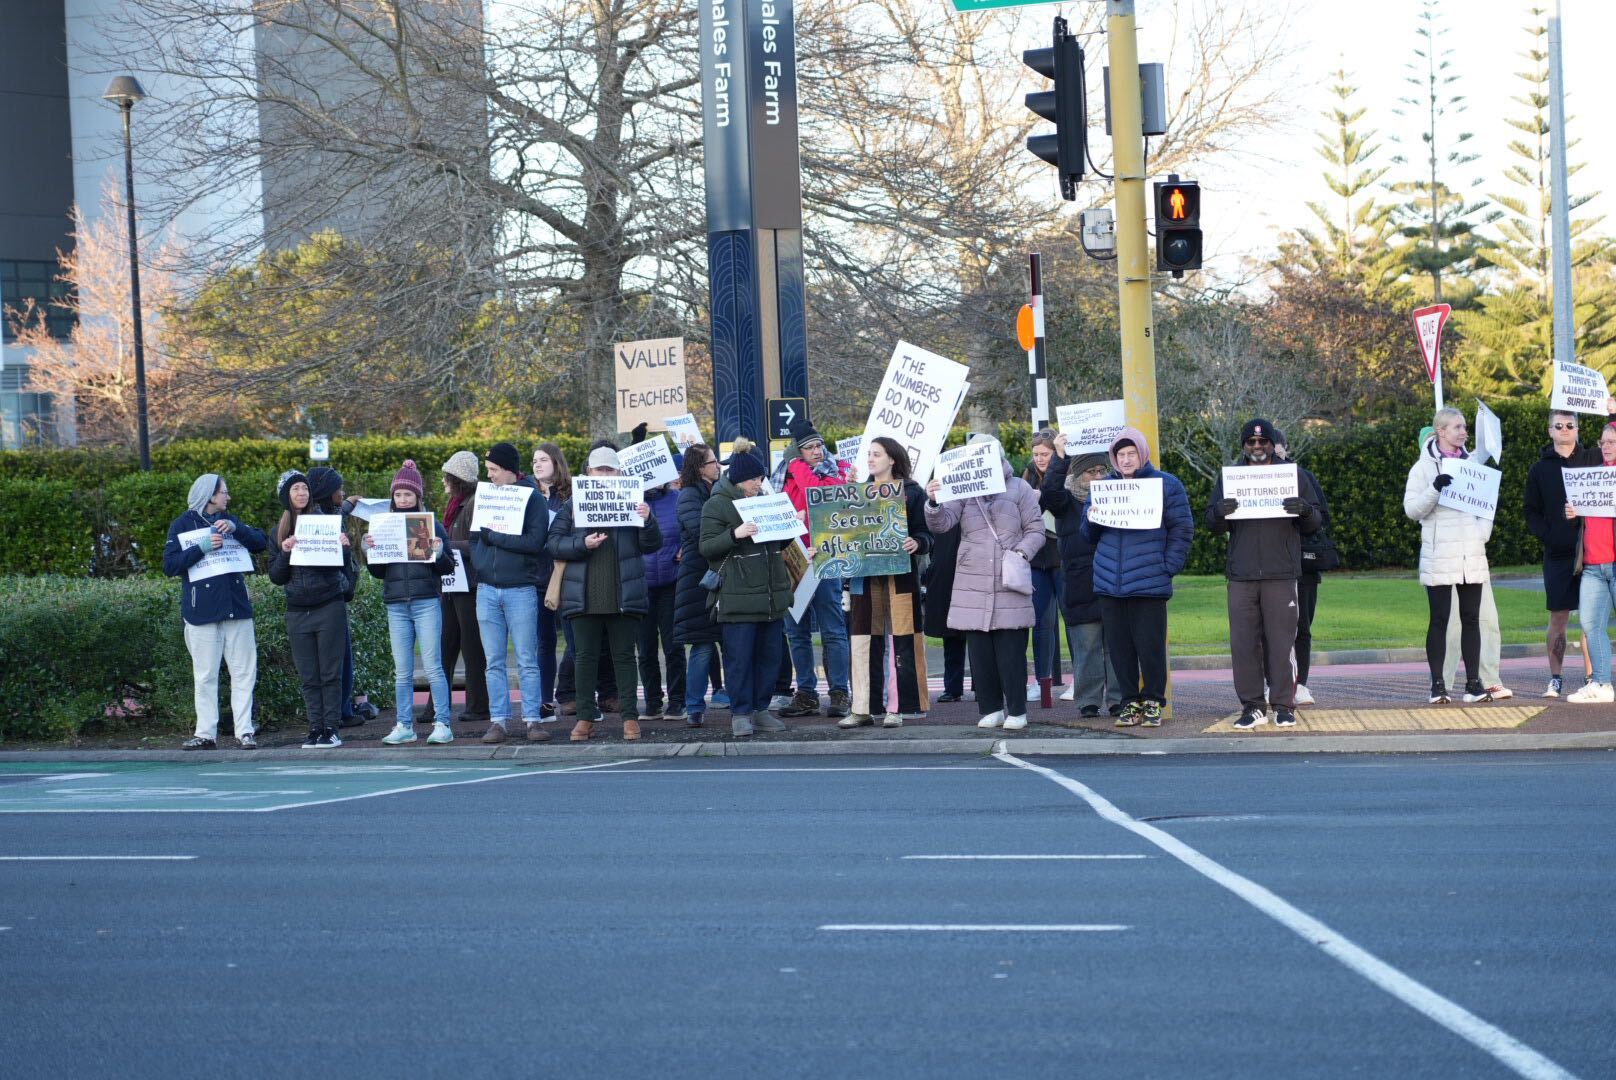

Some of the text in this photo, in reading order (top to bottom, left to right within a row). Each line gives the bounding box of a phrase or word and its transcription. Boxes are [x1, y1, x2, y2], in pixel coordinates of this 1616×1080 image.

[712, 0, 732, 127] ales Farm
[762, 0, 782, 125] ales Farm
[1144, 327, 1150, 338] 5
[620, 346, 676, 370] VALUE
[902, 356, 926, 376] THE
[892, 370, 942, 404] NUMBERS
[1568, 374, 1591, 386] THRIVE
[618, 386, 684, 408] TEACHERS
[1562, 385, 1604, 399] KAIAKO JUST
[886, 388, 929, 418] DO NOT
[877, 408, 924, 439] ADD UP
[1098, 426, 1124, 434] WITHOU
[634, 454, 668, 474] CUTTING
[942, 468, 992, 485] KAIAKO JUST
[577, 480, 640, 489] WE TEACH YOUR
[952, 480, 988, 494] SURVIVE.
[1093, 483, 1140, 492] TEACHERS
[1237, 486, 1294, 496] BUT TURNS OUT
[586, 491, 604, 500] KIDS
[605, 491, 616, 500] TO
[811, 482, 902, 505] DEAR GOV
[579, 502, 638, 512] HIGH WHILE WE
[1243, 500, 1258, 508] CAN
[1458, 494, 1495, 511] SCHOOLS
[587, 513, 632, 522] SCRAPE BY.
[864, 514, 884, 525] me
[821, 532, 900, 558] after class
